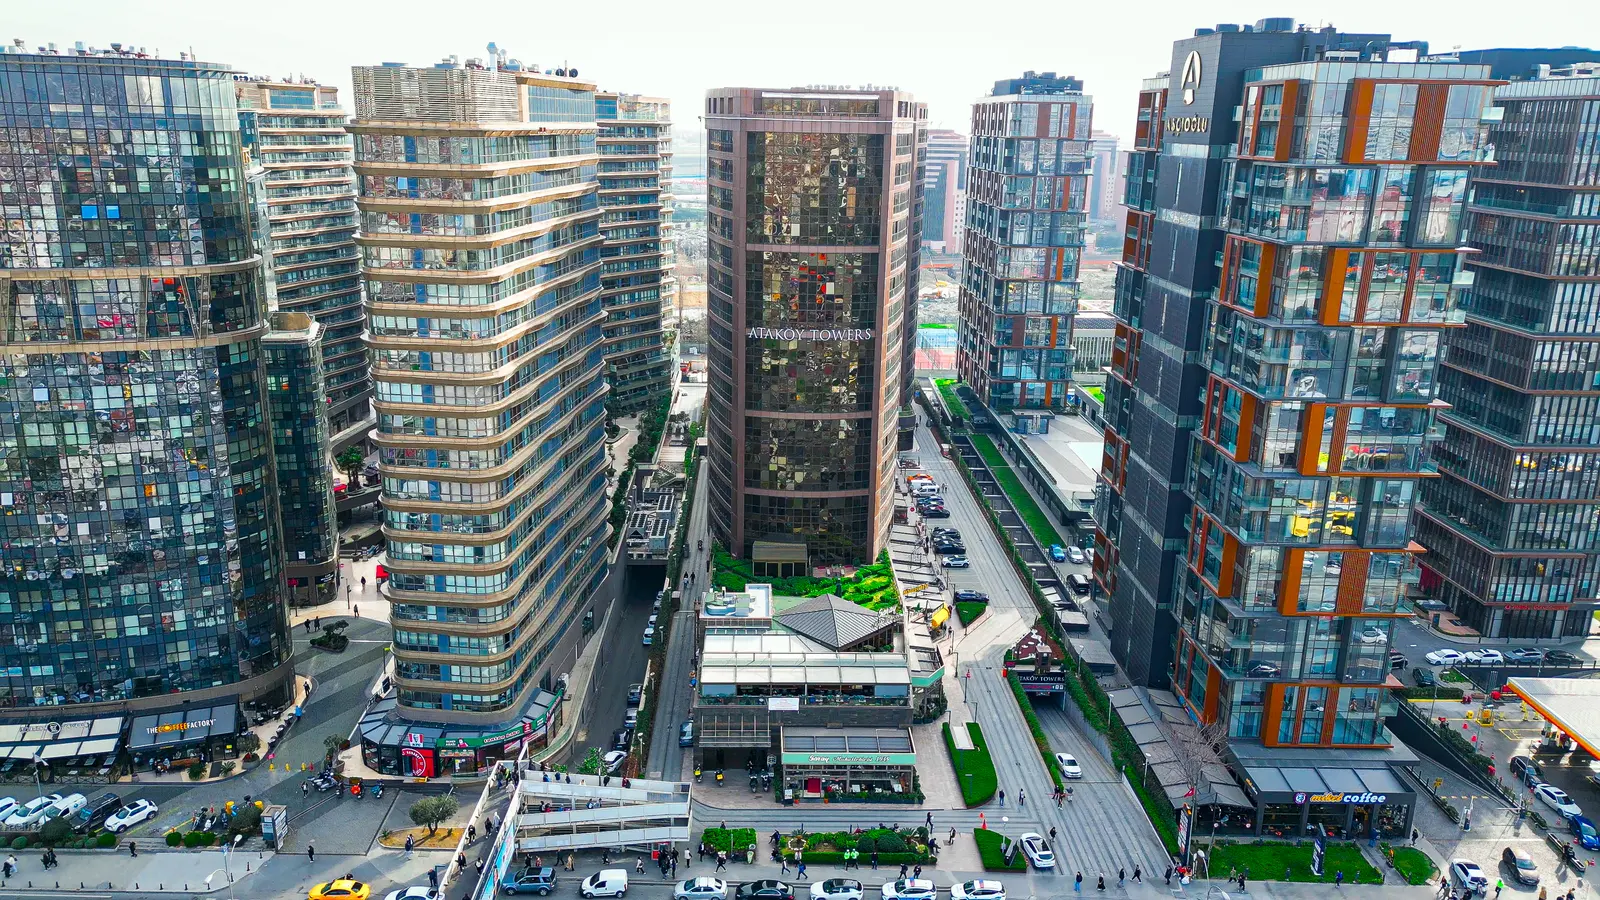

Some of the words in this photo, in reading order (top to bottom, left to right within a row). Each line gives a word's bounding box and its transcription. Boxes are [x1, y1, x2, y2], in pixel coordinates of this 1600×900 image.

[748, 327, 805, 341] ATAKÖY
[810, 328, 872, 341] TOWERS
[1343, 792, 1386, 803] coffee
